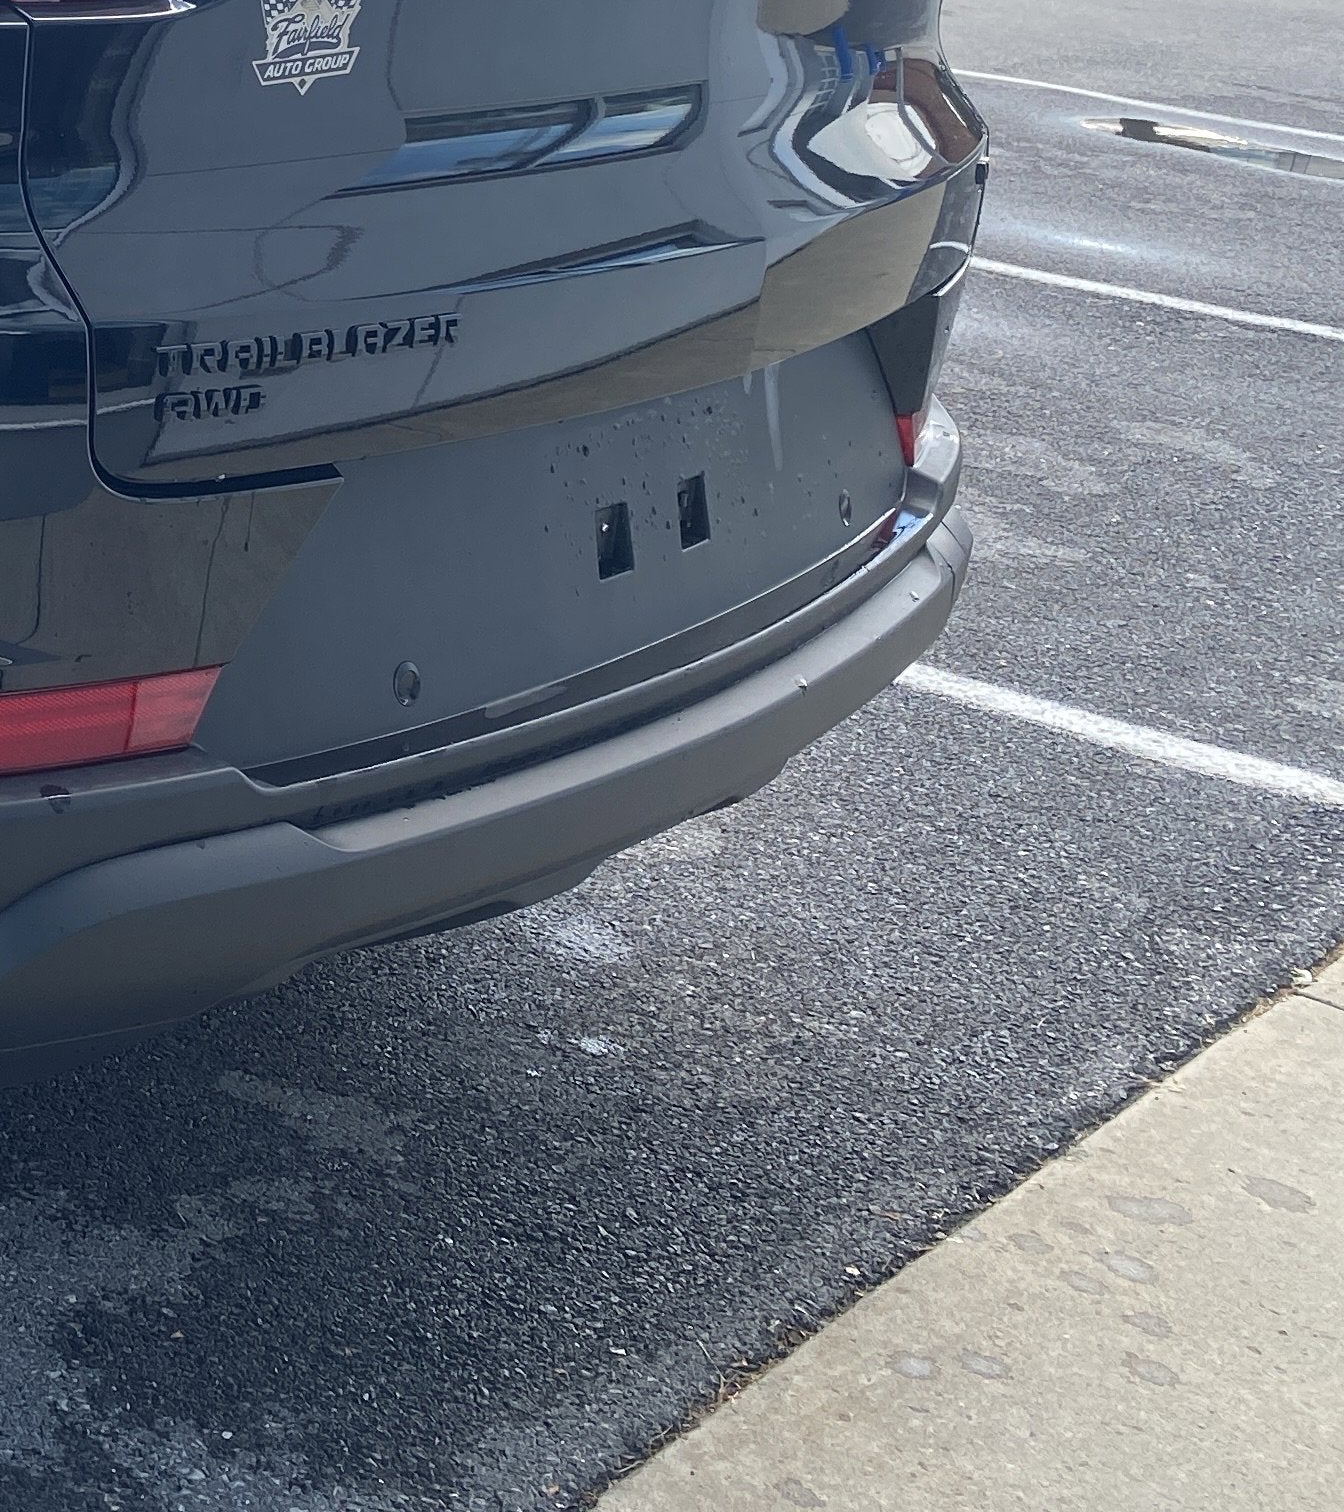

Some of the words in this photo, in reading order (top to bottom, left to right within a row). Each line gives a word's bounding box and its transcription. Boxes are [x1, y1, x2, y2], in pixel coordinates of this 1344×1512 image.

[270, 13, 351, 56] Fairfield
[263, 61, 302, 79] AUTO
[304, 54, 350, 73] GROUP
[153, 312, 461, 378] TRAILBLAZER
